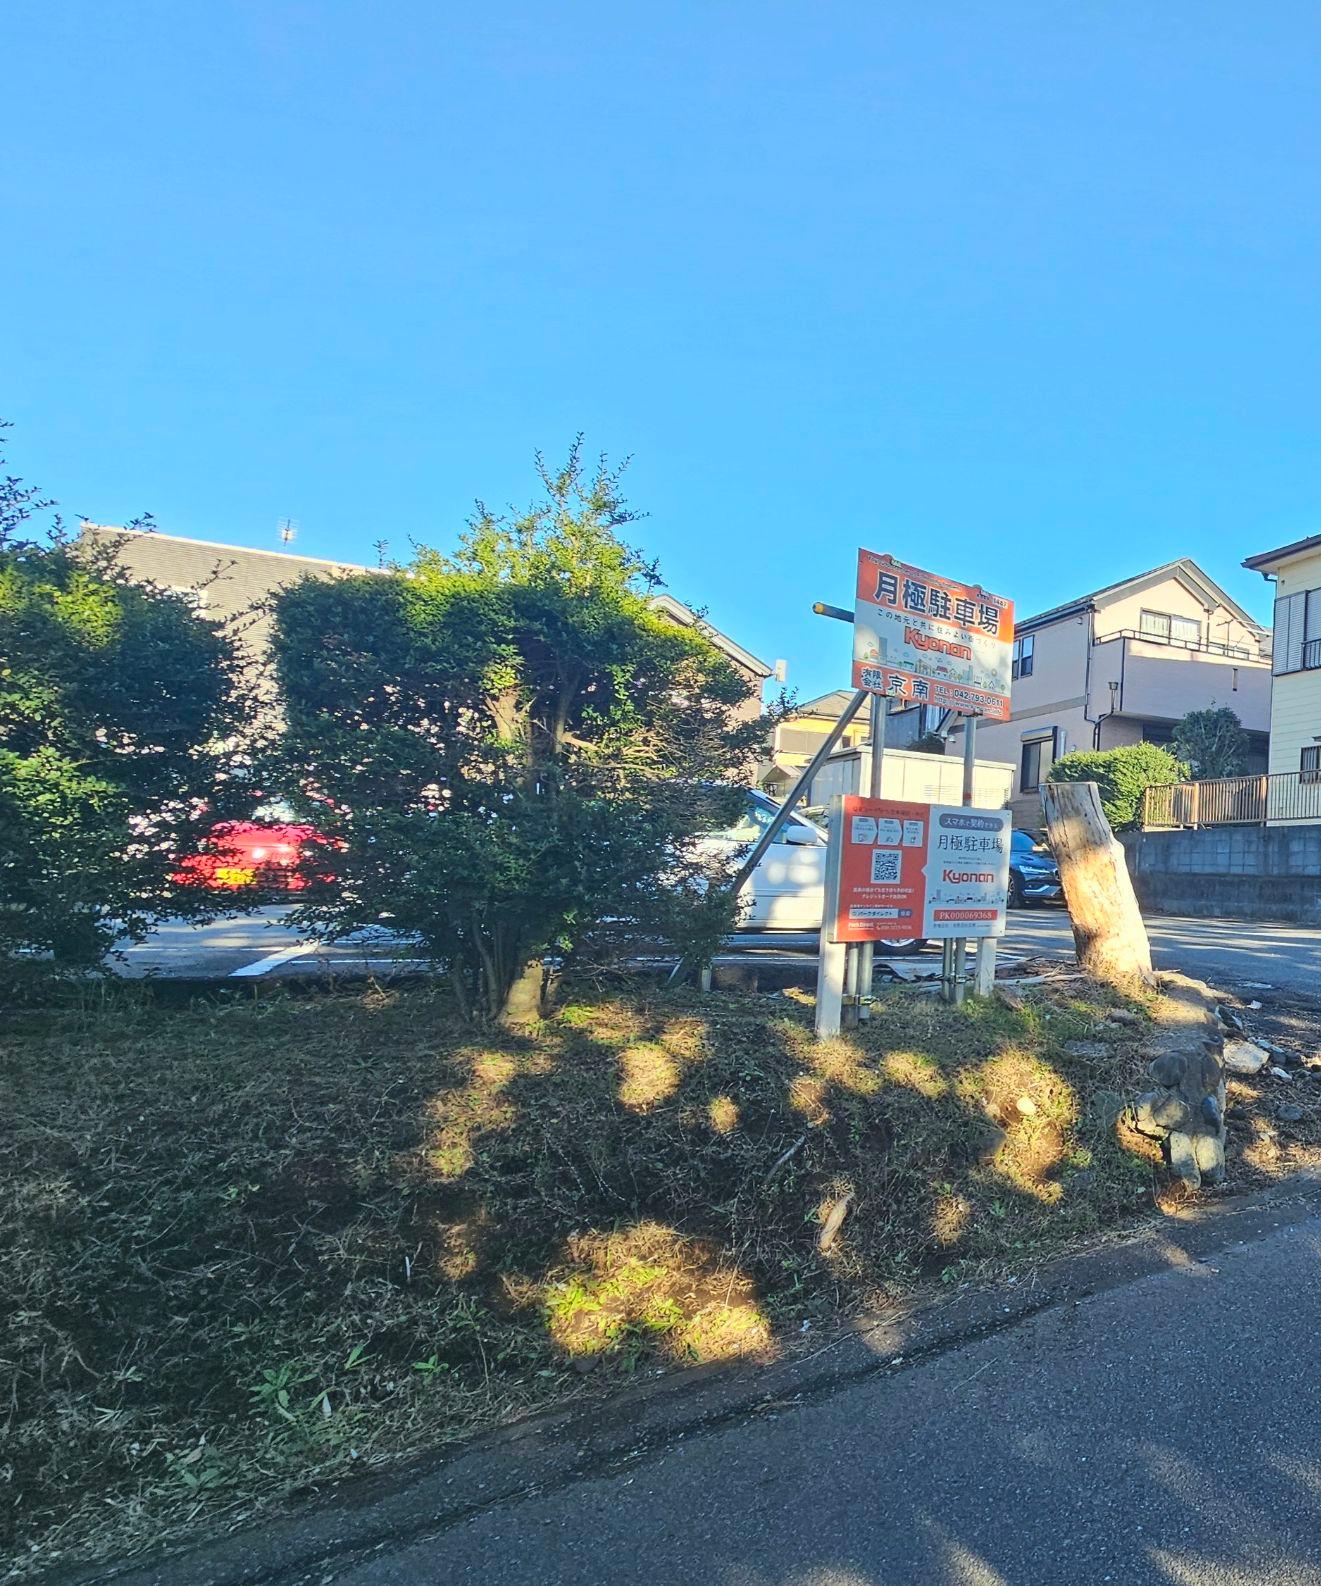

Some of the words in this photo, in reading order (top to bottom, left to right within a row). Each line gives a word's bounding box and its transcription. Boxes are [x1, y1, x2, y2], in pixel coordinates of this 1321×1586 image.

[874, 570, 999, 635] 月極駐車場
[904, 626, 972, 660] Kyonan
[887, 674, 929, 700] 京南
[937, 834, 1004, 853] 月極駐車場
[943, 869, 994, 884] Kyonan
